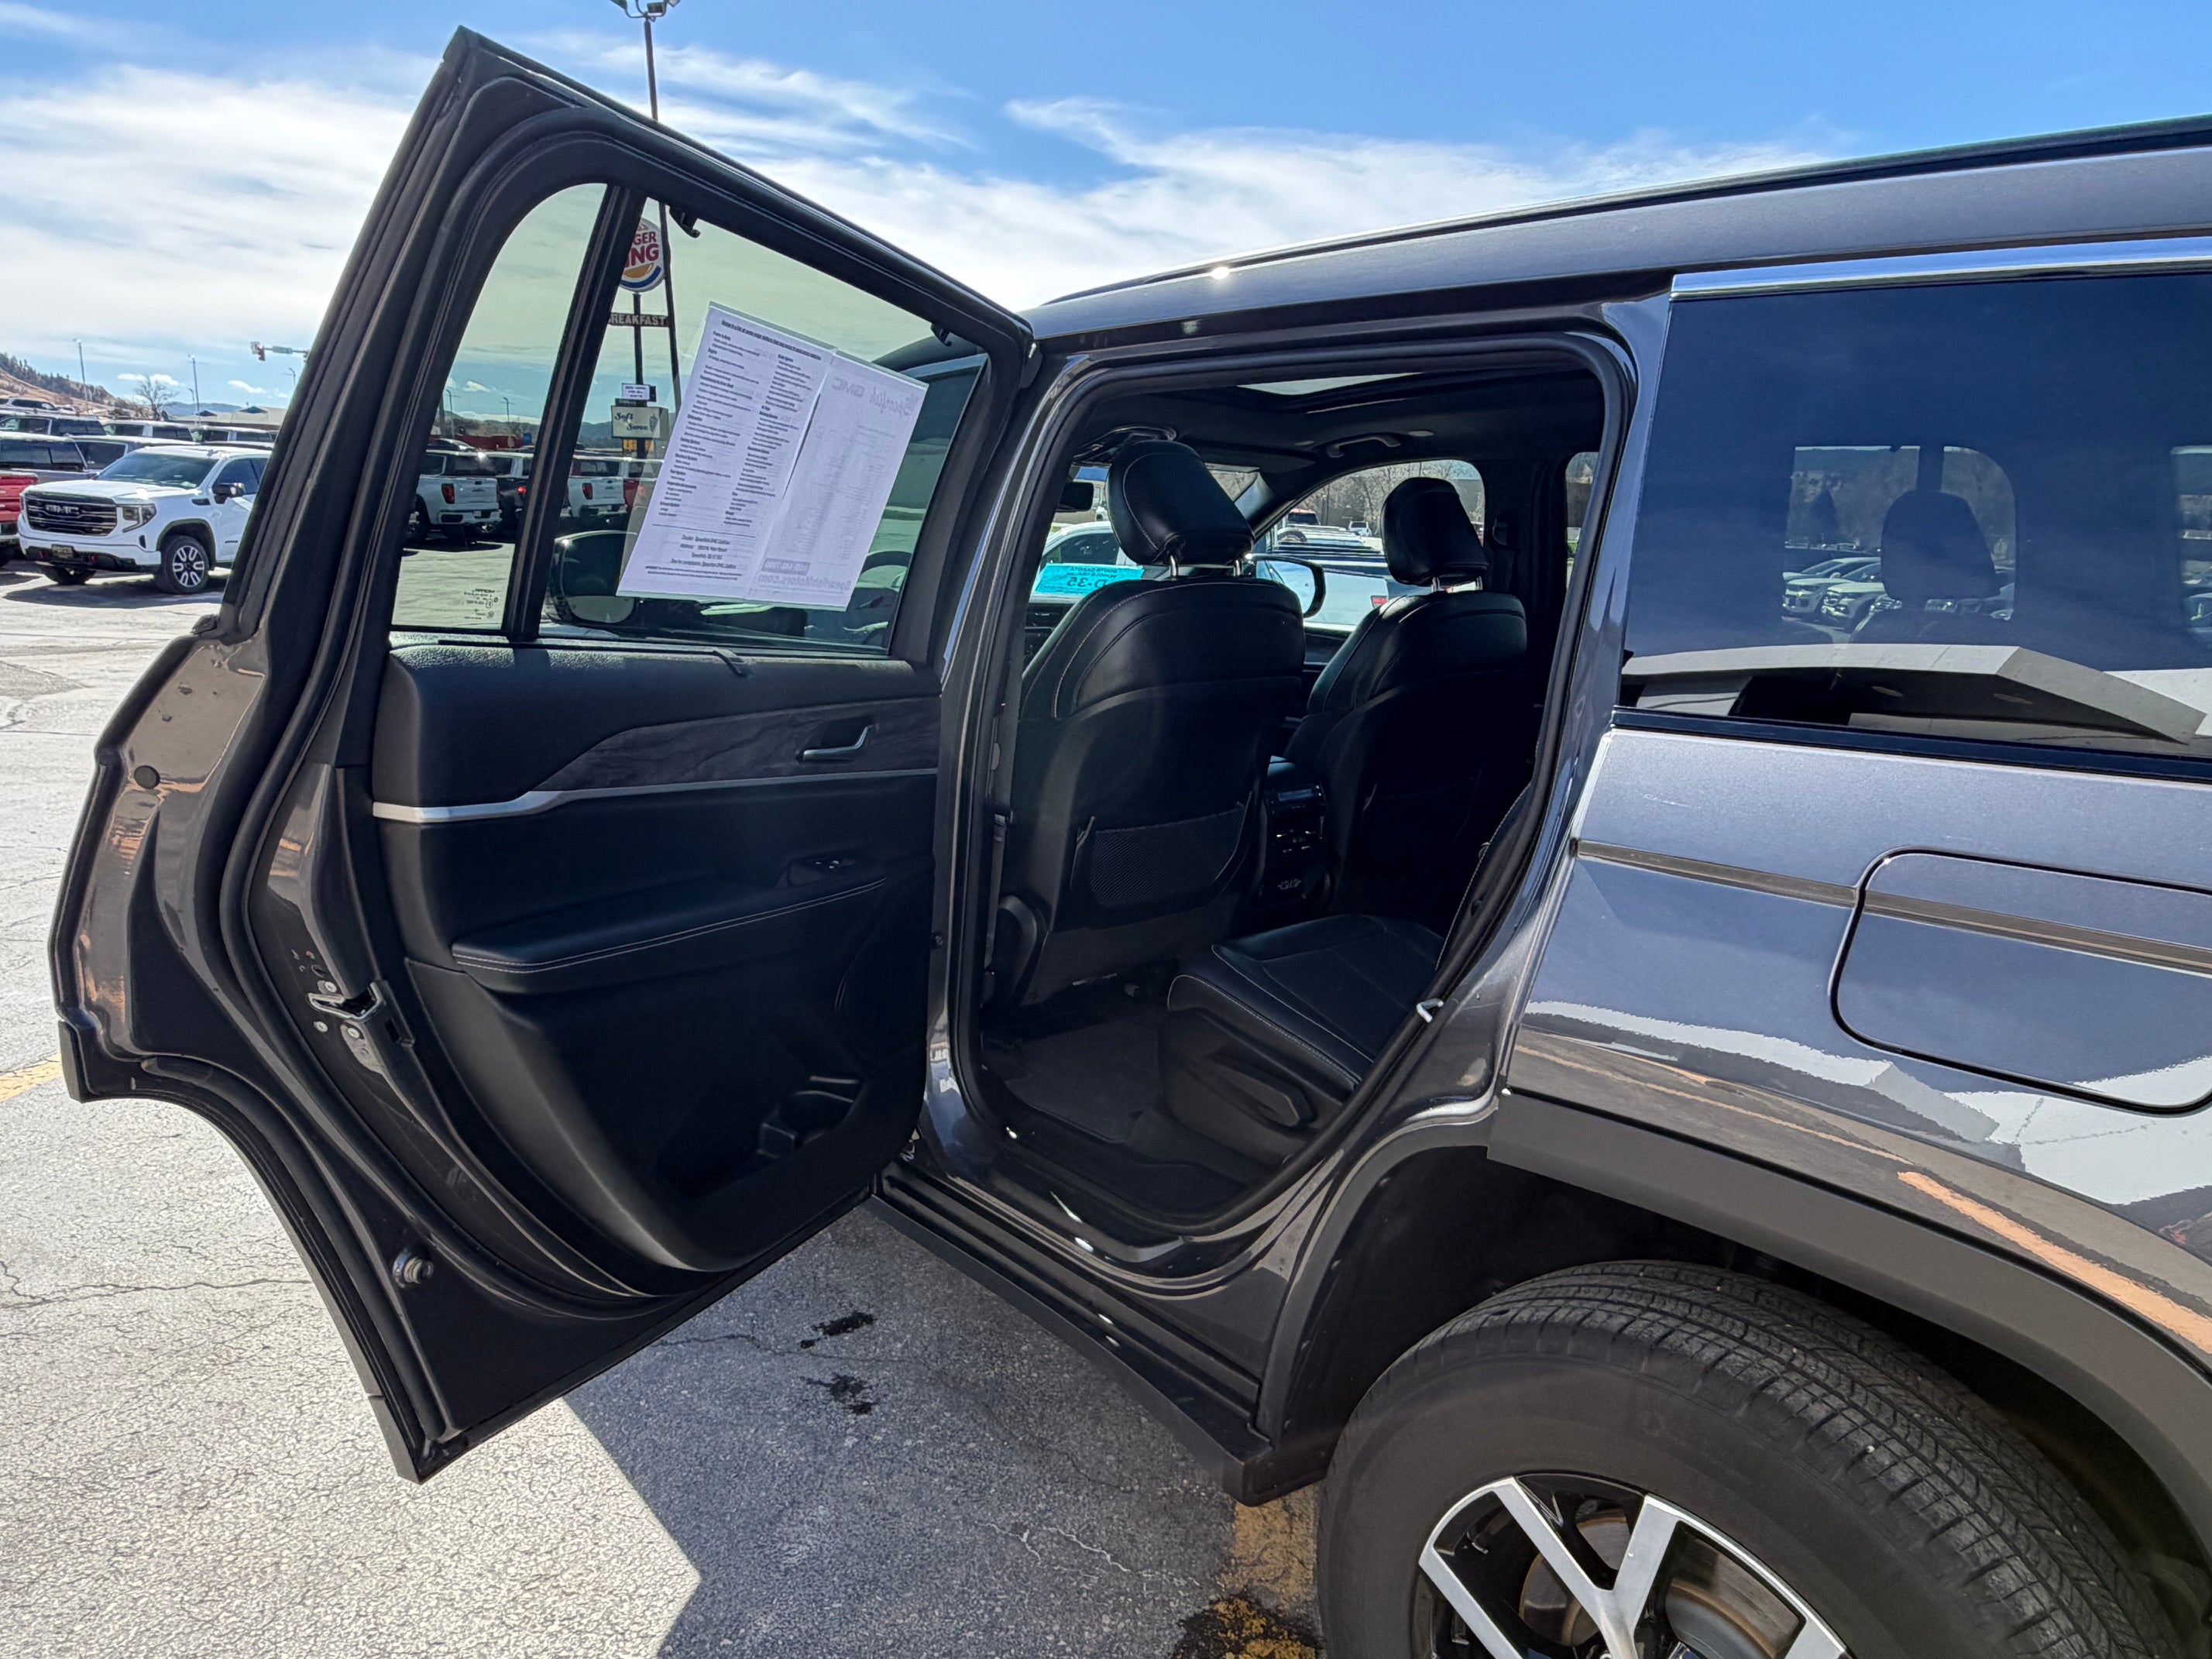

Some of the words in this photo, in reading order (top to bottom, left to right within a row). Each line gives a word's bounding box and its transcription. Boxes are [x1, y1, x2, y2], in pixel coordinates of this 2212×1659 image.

[633, 232, 657, 246] GER
[625, 243, 659, 268] ING
[609, 314, 667, 326] REAKFAST
[614, 411, 634, 422] Soft
[45, 504, 80, 515] GMC
